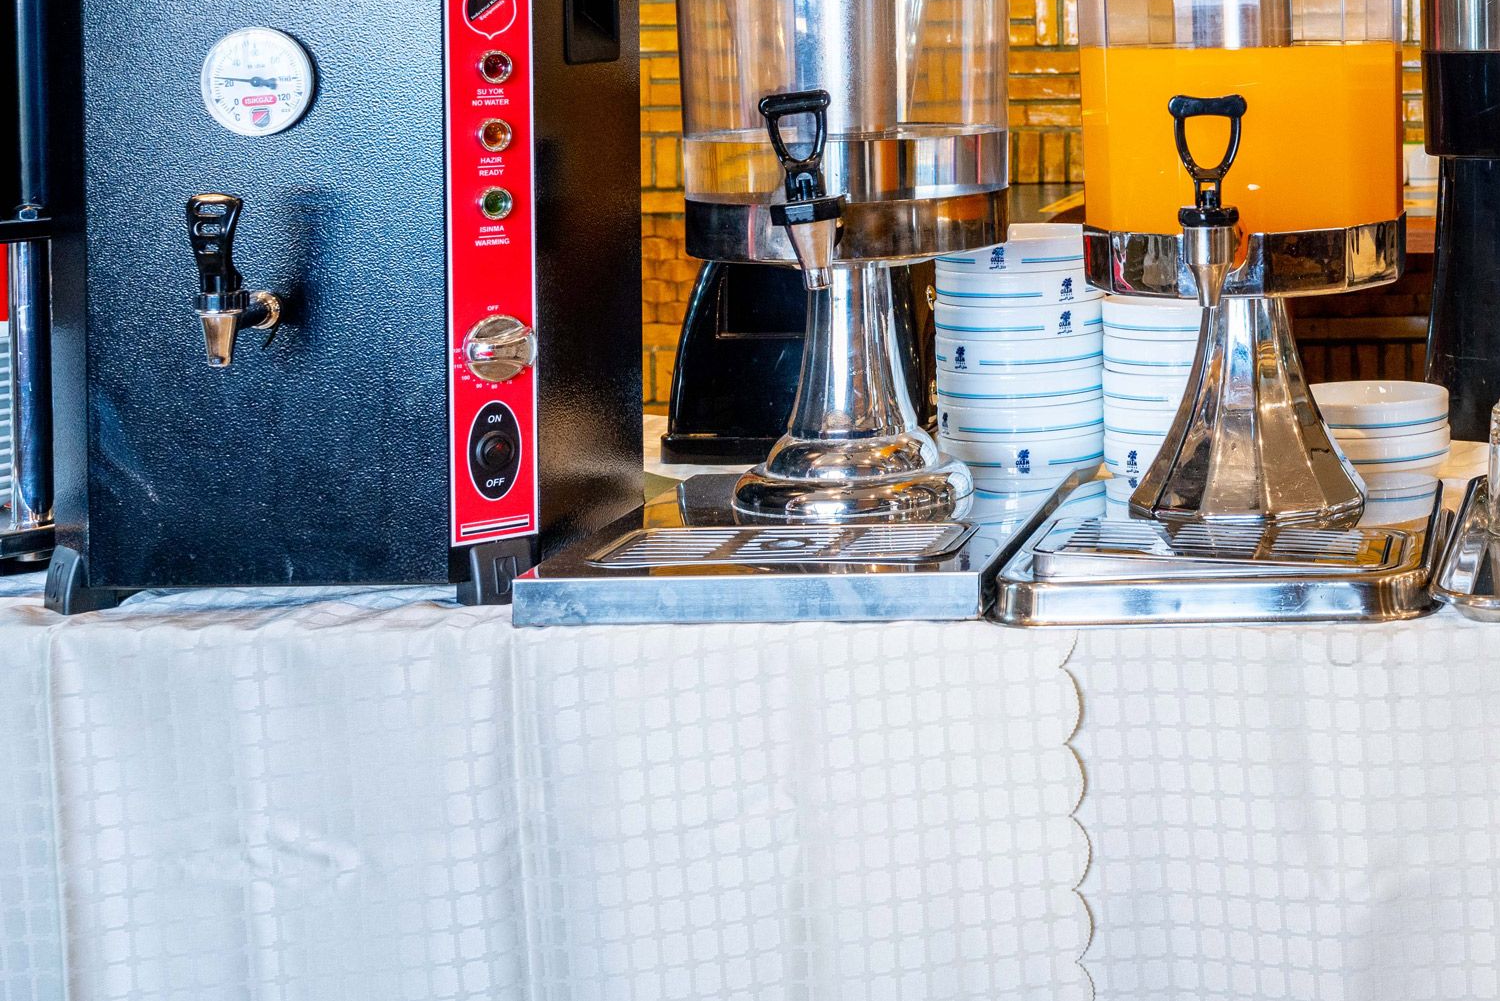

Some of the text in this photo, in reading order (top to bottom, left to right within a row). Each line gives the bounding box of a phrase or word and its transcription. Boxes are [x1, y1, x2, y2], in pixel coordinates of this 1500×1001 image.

[224, 80, 234, 88] 20
[480, 156, 503, 164] HAZIR
[479, 169, 504, 177] READY
[479, 225, 504, 233] ISINMA
[474, 238, 510, 247] WARMING
[487, 414, 502, 424] ON
[486, 477, 505, 488] OFF
